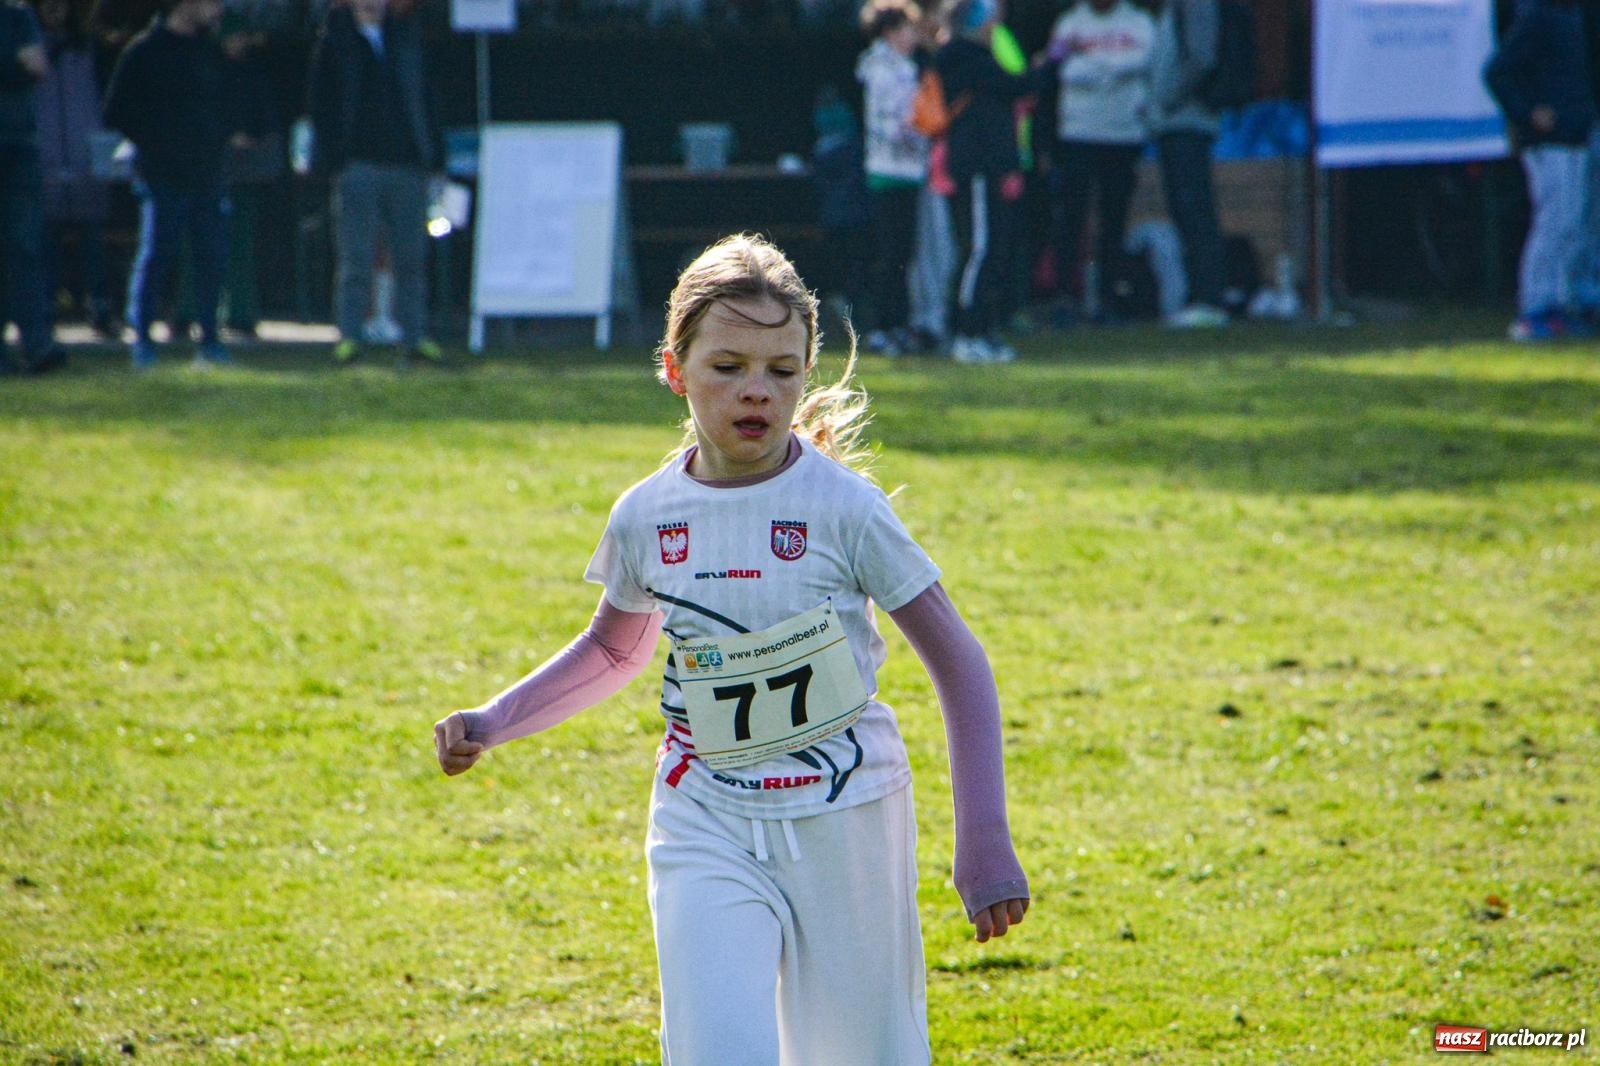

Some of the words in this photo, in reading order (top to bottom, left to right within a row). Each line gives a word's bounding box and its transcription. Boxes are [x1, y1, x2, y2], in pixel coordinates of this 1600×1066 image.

[656, 521, 689, 530] POLSKA
[727, 619, 830, 661] www.personalbest.pl
[712, 663, 814, 742] 77
